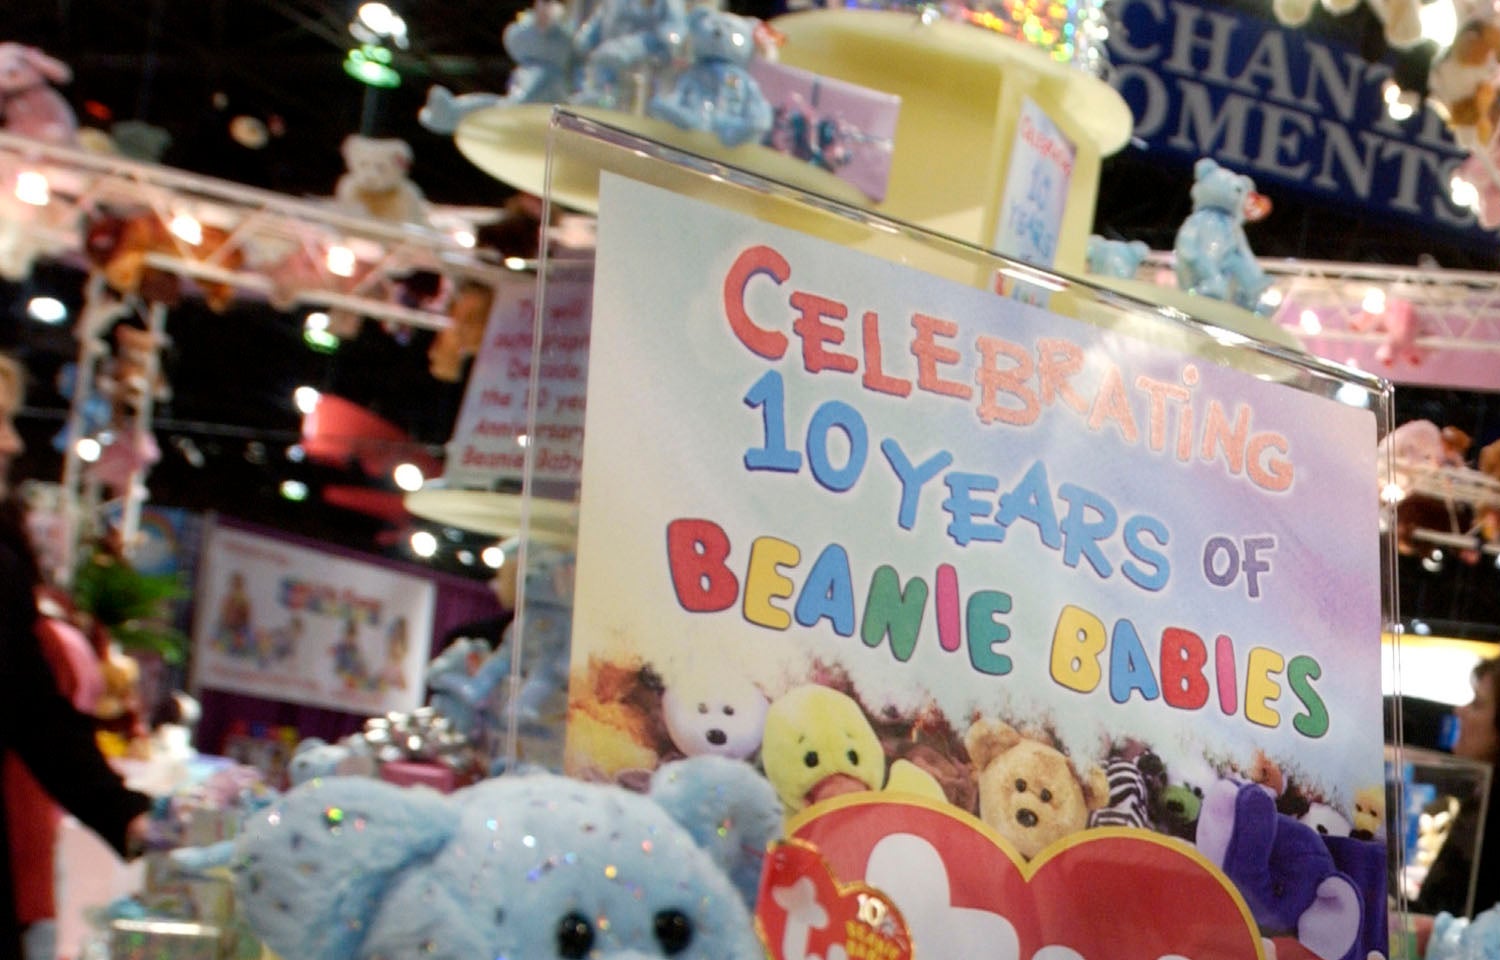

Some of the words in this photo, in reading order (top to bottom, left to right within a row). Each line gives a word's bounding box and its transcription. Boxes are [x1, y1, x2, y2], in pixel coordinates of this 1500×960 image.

[743, 369, 869, 492] 10
[880, 437, 1170, 591] YEARS
[1203, 535, 1276, 598] OF
[666, 517, 1013, 676] BEANIE
[1049, 604, 1330, 739] BABIES
